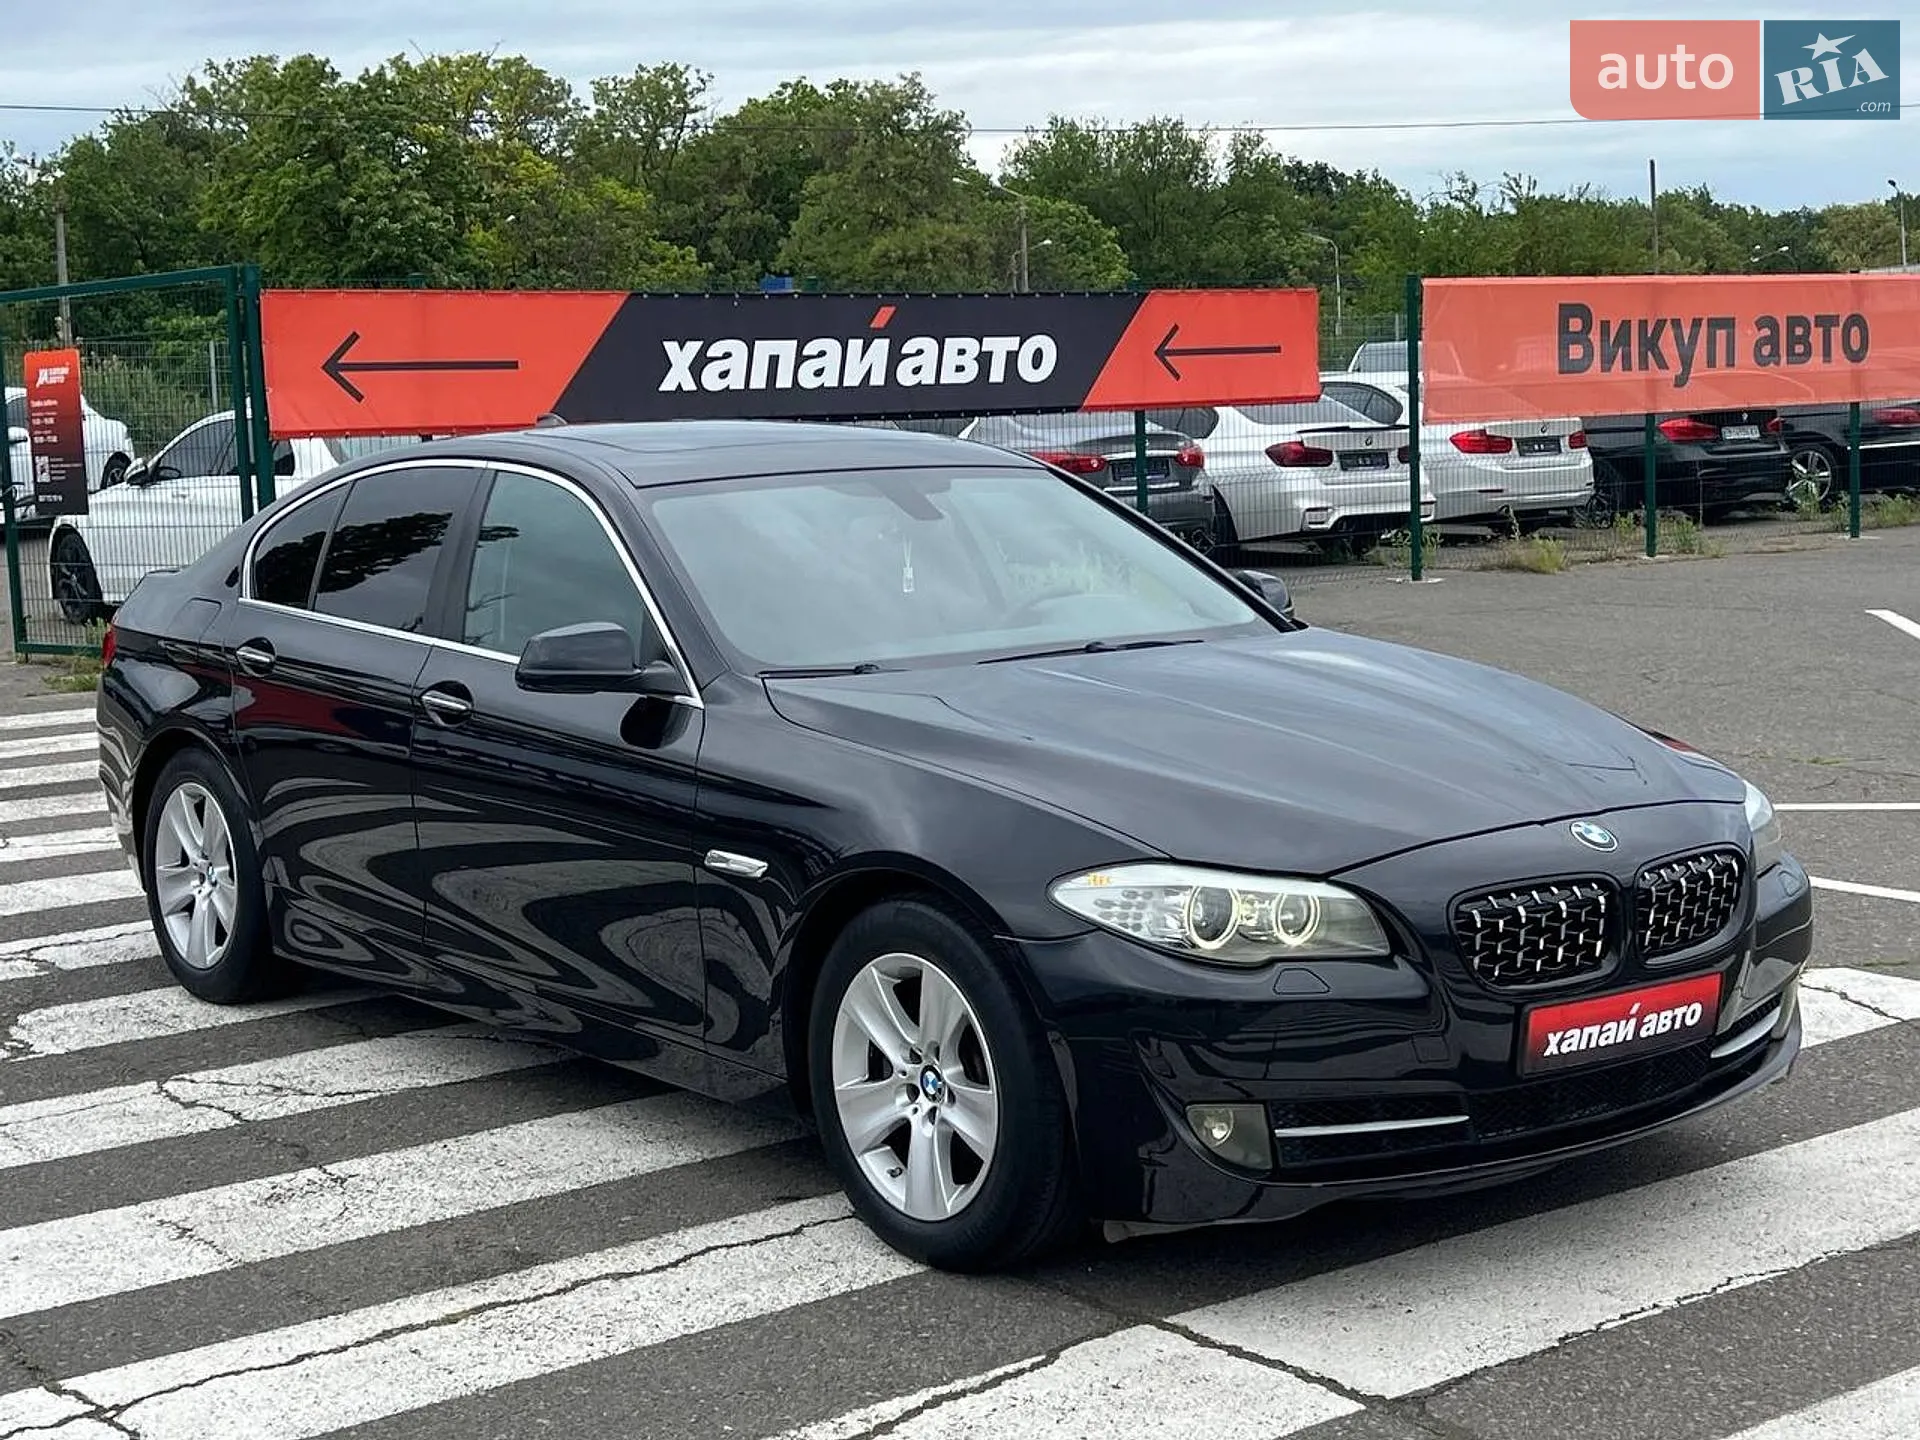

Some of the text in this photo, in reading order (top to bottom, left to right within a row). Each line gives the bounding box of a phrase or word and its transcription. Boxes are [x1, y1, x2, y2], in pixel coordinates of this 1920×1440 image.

[896, 333, 1058, 388] авто
[1558, 302, 1870, 388] Викуп авто
[1638, 1001, 1703, 1039] авто
